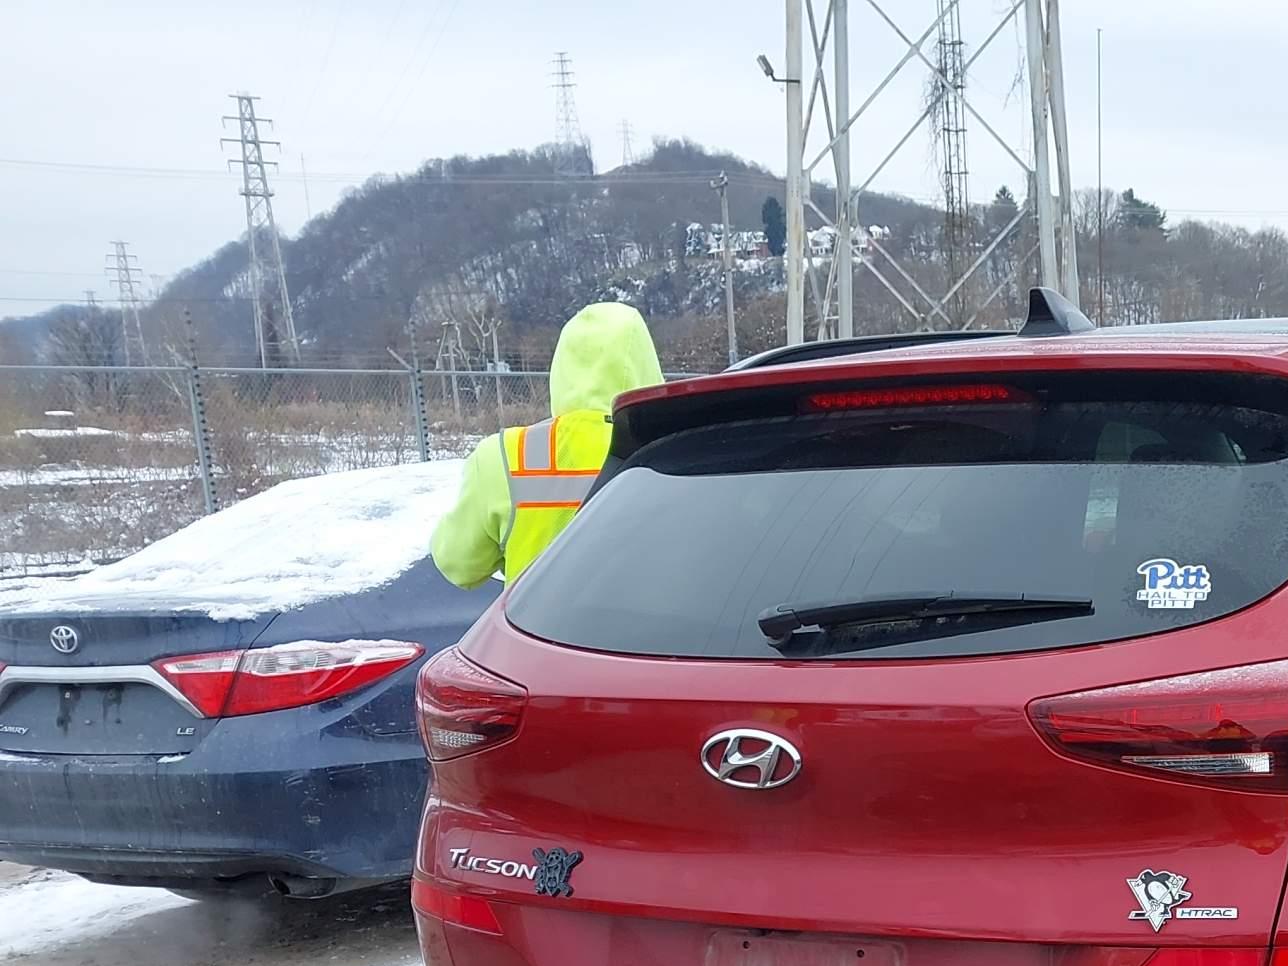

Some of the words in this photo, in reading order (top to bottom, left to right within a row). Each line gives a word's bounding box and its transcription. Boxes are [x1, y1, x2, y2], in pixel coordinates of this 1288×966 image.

[1139, 560, 1209, 590] Pitt
[1138, 590, 1177, 600] HAIL
[1183, 590, 1206, 600] TO
[1150, 599, 1190, 607] PITT
[176, 727, 195, 735] LE
[1180, 909, 1233, 917] HTRAC
